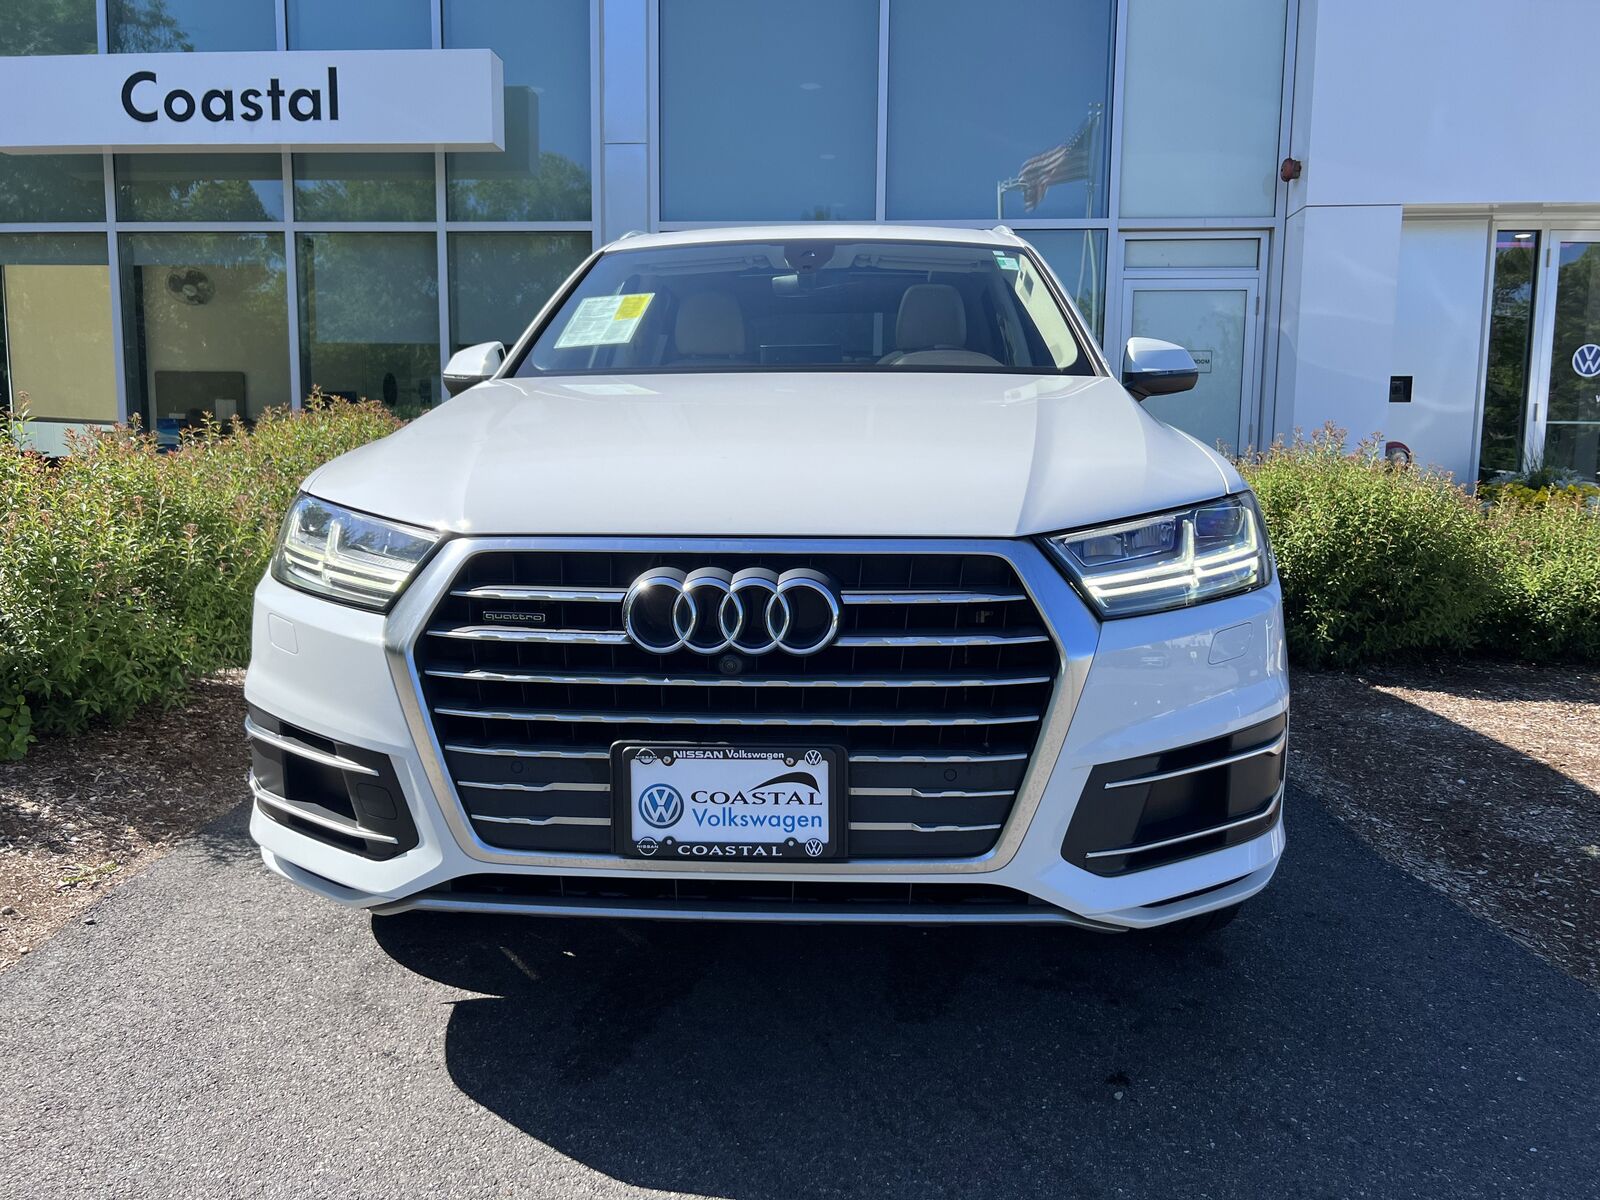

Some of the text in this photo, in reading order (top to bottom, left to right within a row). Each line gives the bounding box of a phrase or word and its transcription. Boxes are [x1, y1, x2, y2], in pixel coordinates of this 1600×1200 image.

[121, 67, 339, 122] Coastal
[673, 749, 785, 760] NISSAN Volkswagen
[690, 790, 823, 806] COASTAL
[692, 807, 822, 833] Volkswagen
[677, 845, 783, 856] COASTAL
